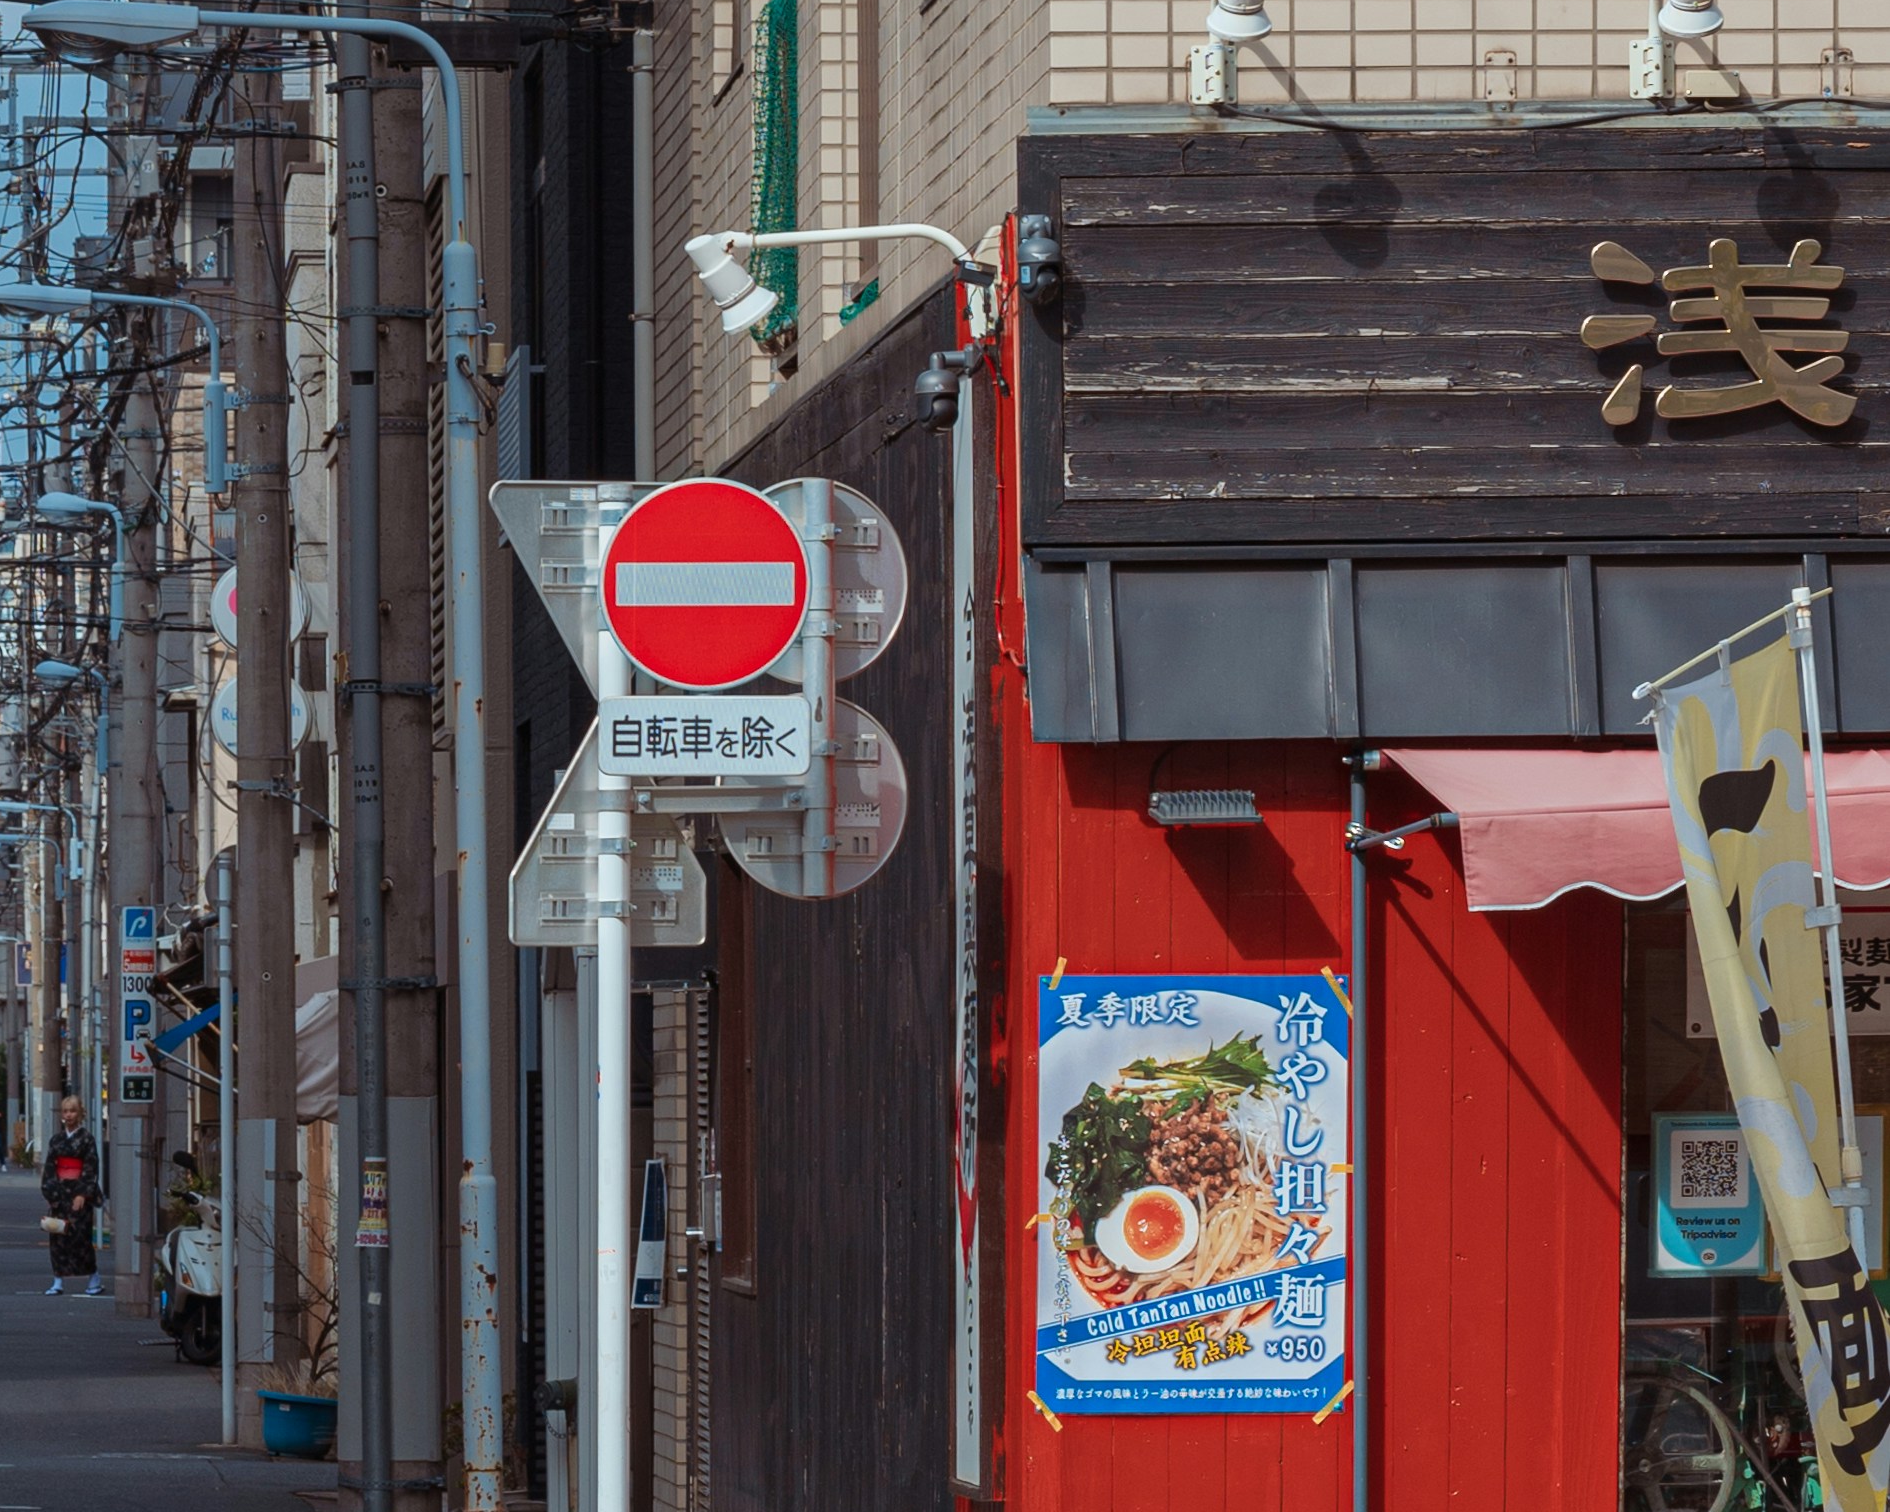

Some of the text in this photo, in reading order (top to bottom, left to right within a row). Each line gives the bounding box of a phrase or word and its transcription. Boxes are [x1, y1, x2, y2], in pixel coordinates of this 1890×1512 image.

[1579, 237, 1859, 428] 浅
[611, 715, 797, 759] 自転車を除く
[1055, 992, 1200, 1027] 夏季限定
[1274, 992, 1327, 1329] 冷やし担々麺
[1676, 1216, 1741, 1226] Review us on
[1680, 1229, 1738, 1241] Tripadvisor
[1087, 1314, 1125, 1336] Cold
[1128, 1301, 1189, 1328] TanTan
[1106, 1321, 1206, 1364] 冷坦坦面
[1174, 1333, 1252, 1370] 有点辣
